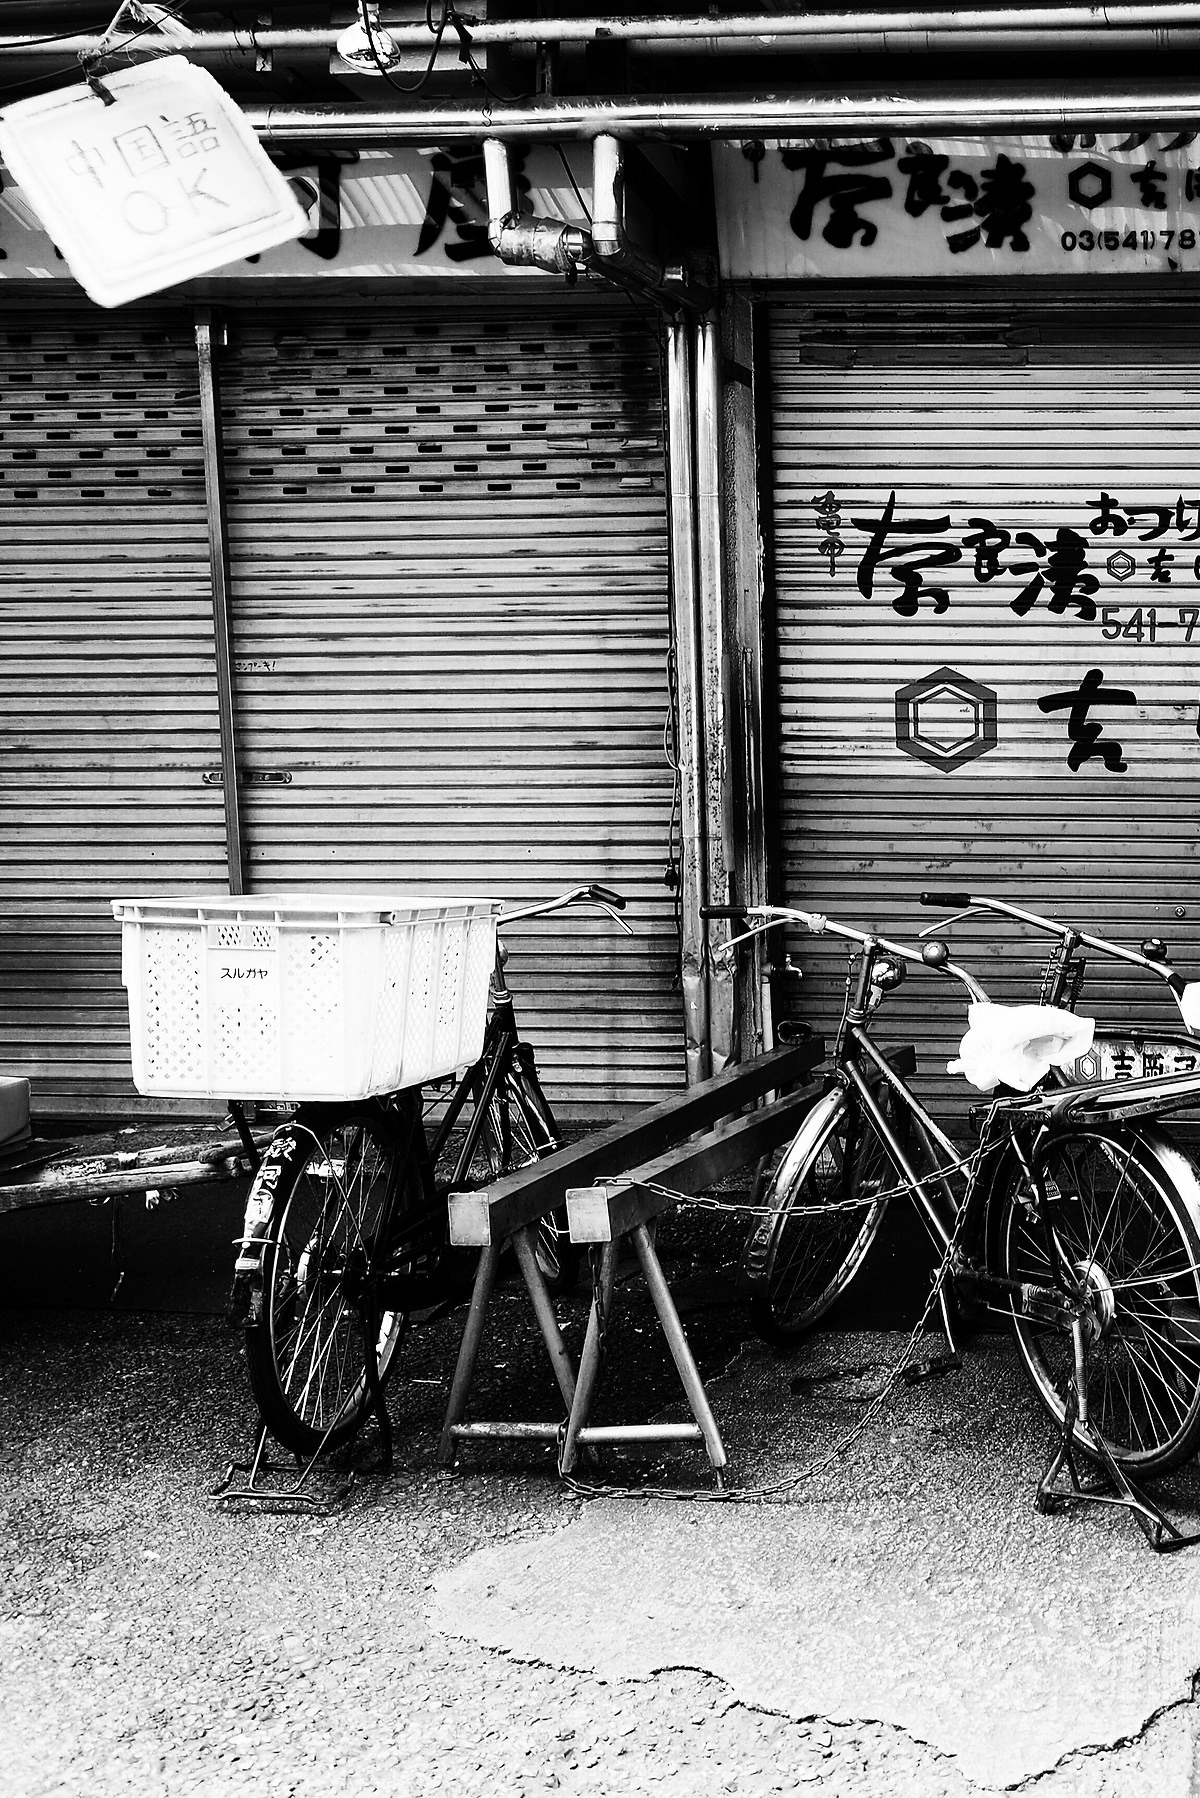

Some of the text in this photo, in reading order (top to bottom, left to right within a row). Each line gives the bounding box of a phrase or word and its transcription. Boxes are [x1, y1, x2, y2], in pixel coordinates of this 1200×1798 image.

[64, 111, 221, 189] 中国語
[121, 167, 231, 236] OK
[220, 967, 268, 979] スルガヤ
